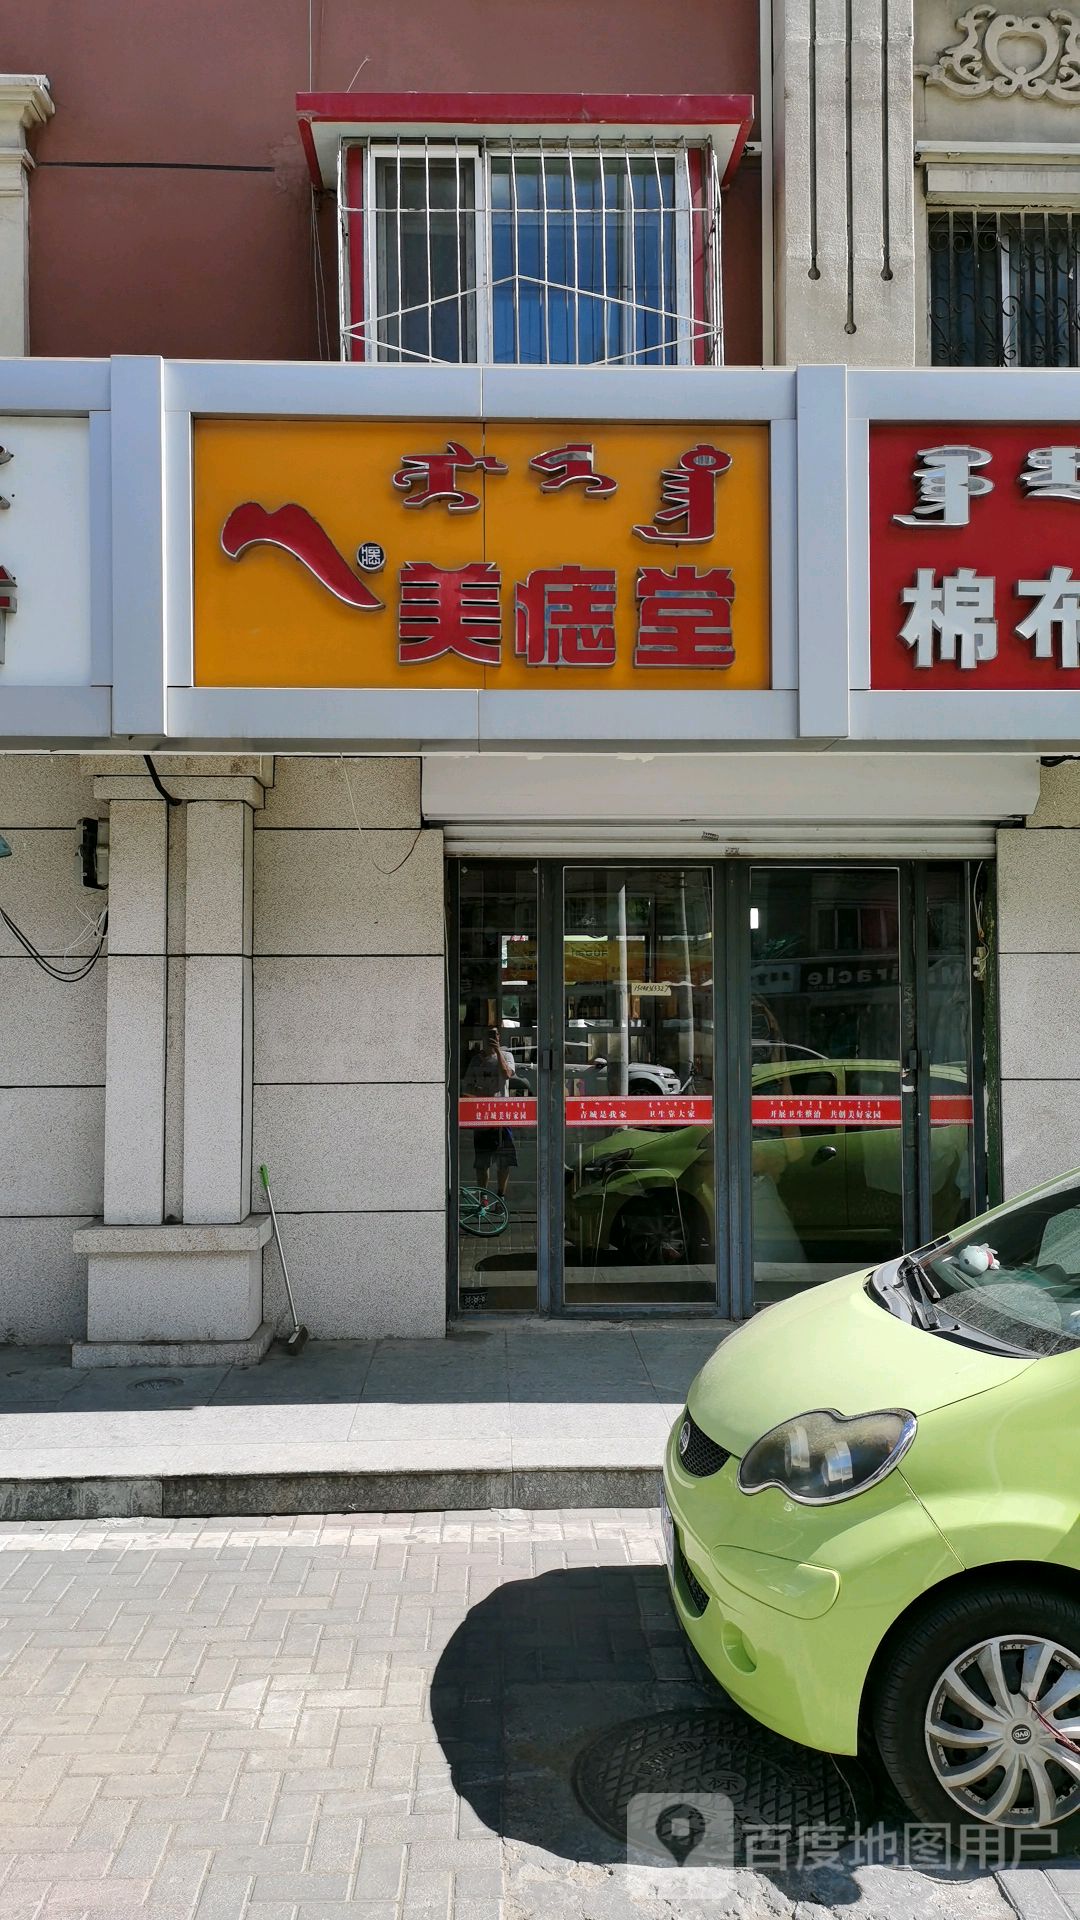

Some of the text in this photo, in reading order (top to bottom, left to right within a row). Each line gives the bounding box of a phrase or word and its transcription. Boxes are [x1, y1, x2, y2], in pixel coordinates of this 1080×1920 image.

[398, 561, 736, 670] 美痣堂
[579, 1110, 696, 1120] 青城是我家 卫生靠大家
[770, 1110, 882, 1120] 开展卫生整治 共创美好家园
